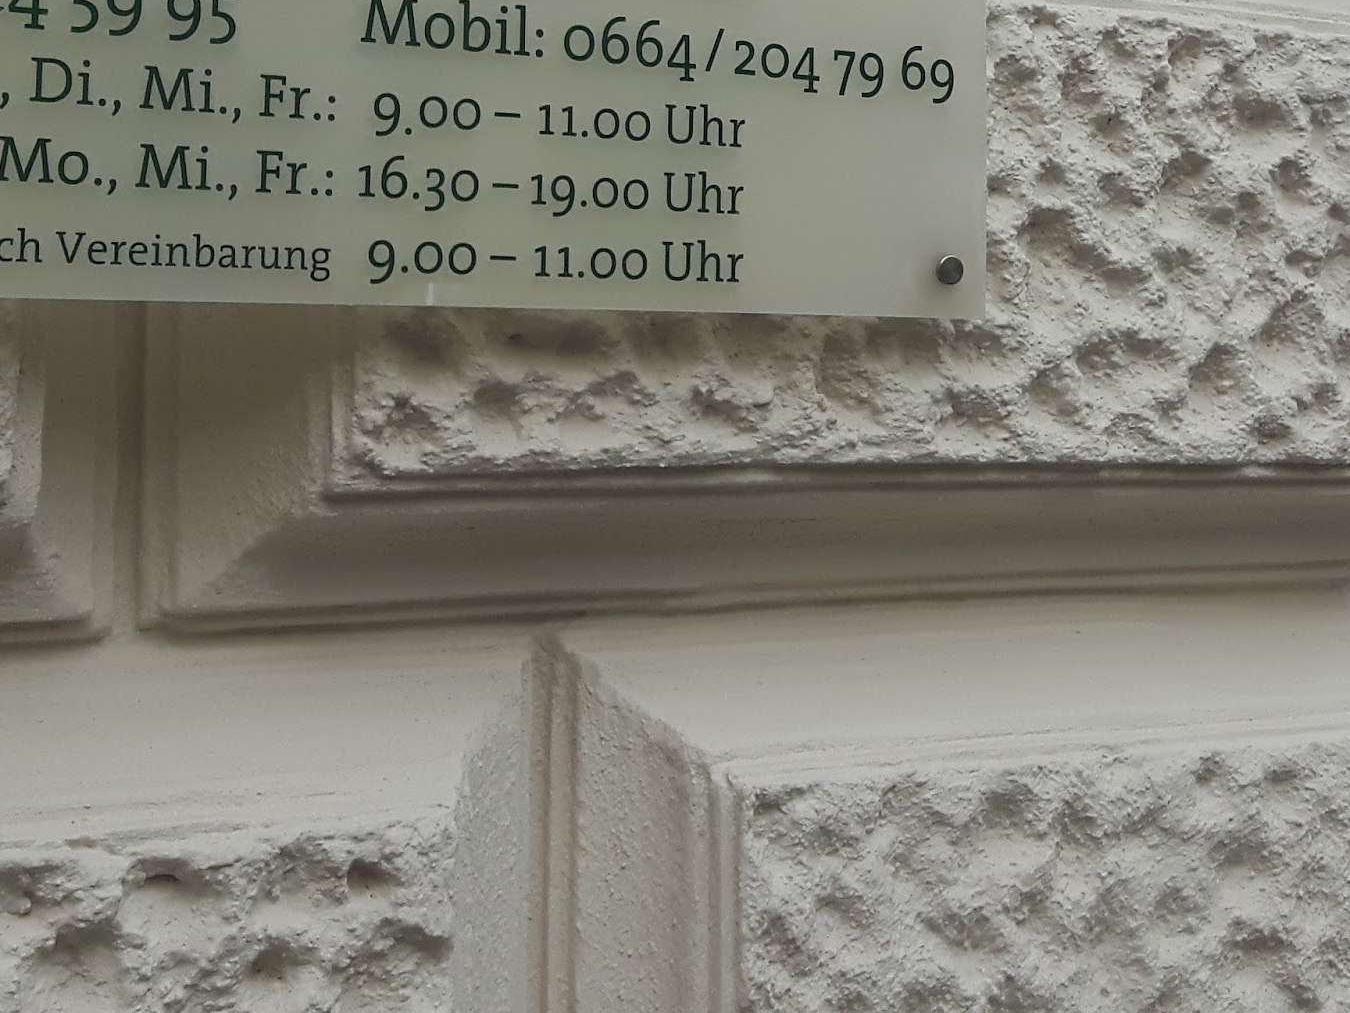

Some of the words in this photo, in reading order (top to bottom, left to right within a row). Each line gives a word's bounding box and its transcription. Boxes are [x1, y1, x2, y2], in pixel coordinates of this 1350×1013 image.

[28, 56, 122, 117] Di.,
[138, 65, 242, 125] Mi.,
[258, 73, 337, 123] Fr.:
[373, 92, 482, 137] 9.00
[538, 103, 651, 142] 11.00
[664, 103, 746, 149] Uhr
[833, 49, 885, 99] 79
[900, 45, 955, 105] 69
[0, 135, 117, 196] Mo.,
[134, 143, 238, 201] Mi.,
[254, 149, 334, 197] Fr.:
[357, 154, 480, 213] 16.30
[530, 173, 650, 218] 19.00
[663, 170, 745, 215] Uhr
[0, 227, 44, 264] ch
[55, 230, 332, 283] Vereinbarung
[368, 239, 477, 285] 9.00
[534, 245, 648, 281] 11.00
[661, 239, 745, 284] Uhr
